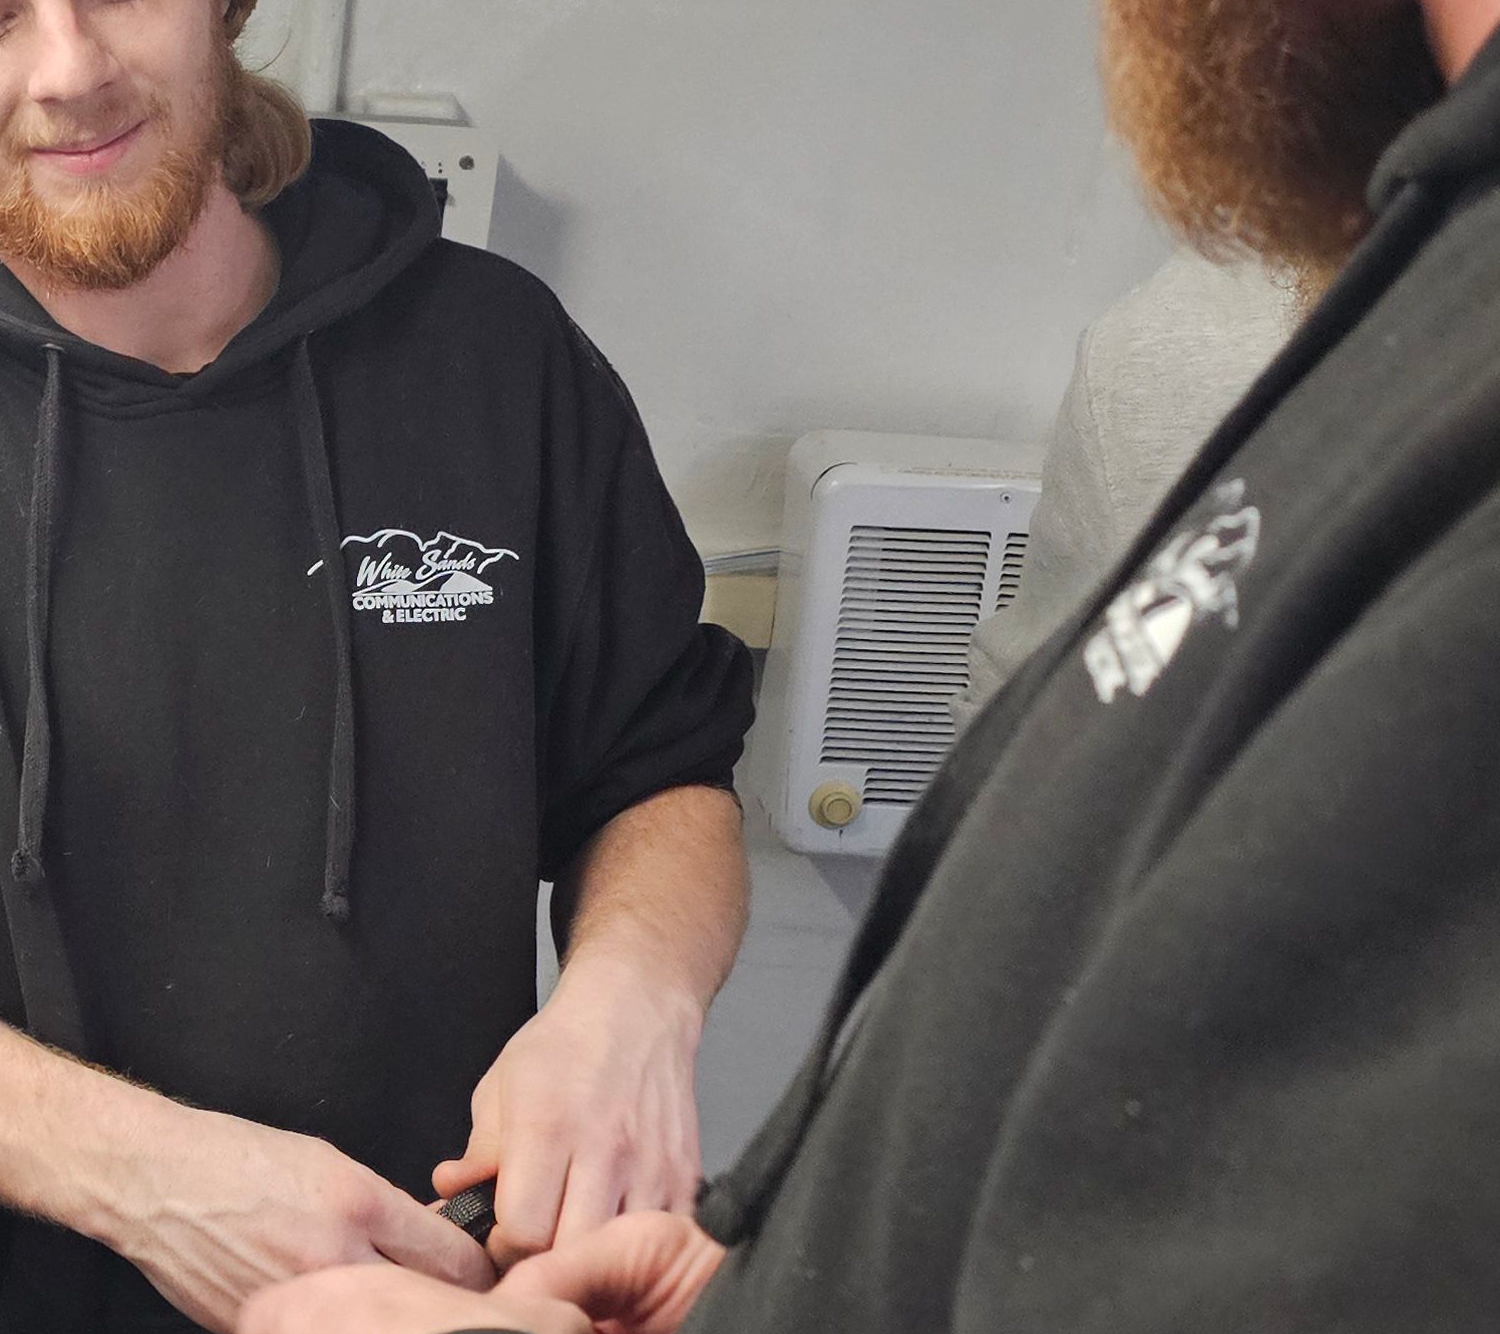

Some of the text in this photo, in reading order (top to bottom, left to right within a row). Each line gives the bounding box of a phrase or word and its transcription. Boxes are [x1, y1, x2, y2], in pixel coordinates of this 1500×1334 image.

[356, 549, 476, 586] White Sands
[352, 591, 494, 610] COMMUNICATIONS
[382, 608, 466, 624] & ELECTRIC
